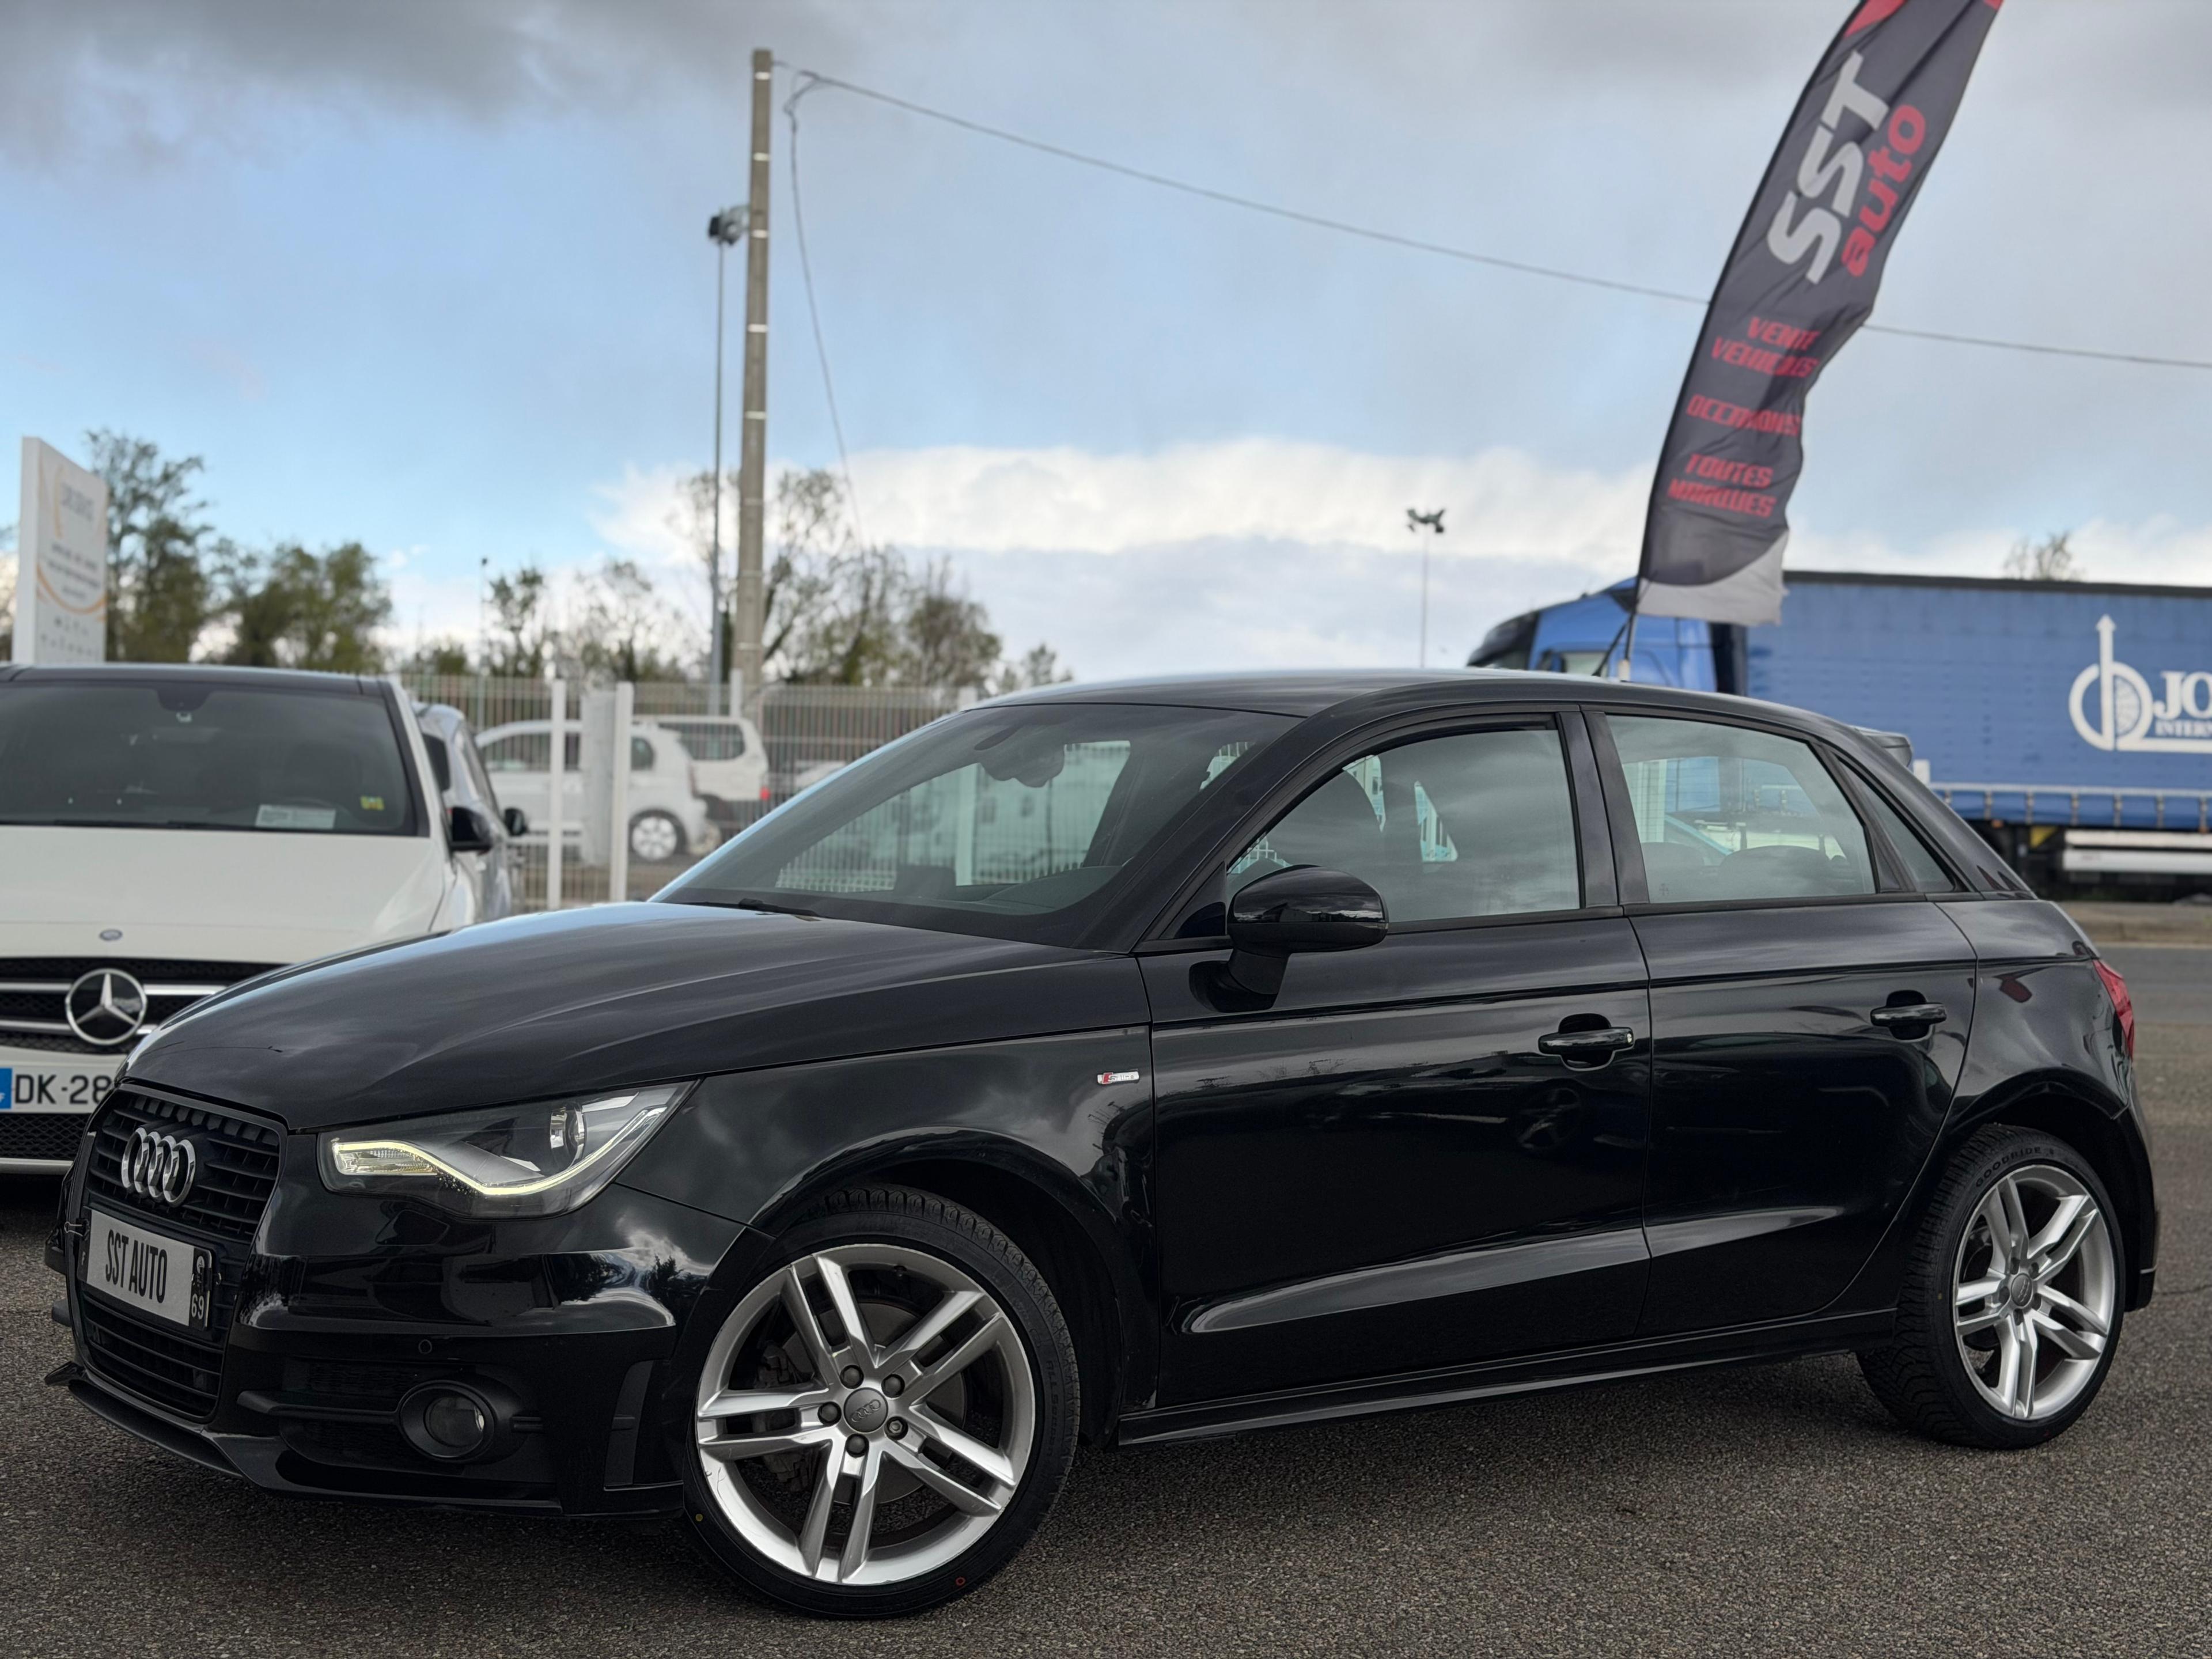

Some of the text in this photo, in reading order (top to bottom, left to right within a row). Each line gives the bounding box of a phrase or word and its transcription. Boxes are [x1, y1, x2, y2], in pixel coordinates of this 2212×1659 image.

[1767, 50, 1890, 284] SST
[1841, 104, 1926, 277] auto
[1685, 453, 1774, 488] TOUTES
[1668, 478, 1777, 517] MARQUES
[14, 1074, 112, 1104] DK-28
[105, 1229, 167, 1304] SST AUTO
[191, 1293, 204, 1320] 69
